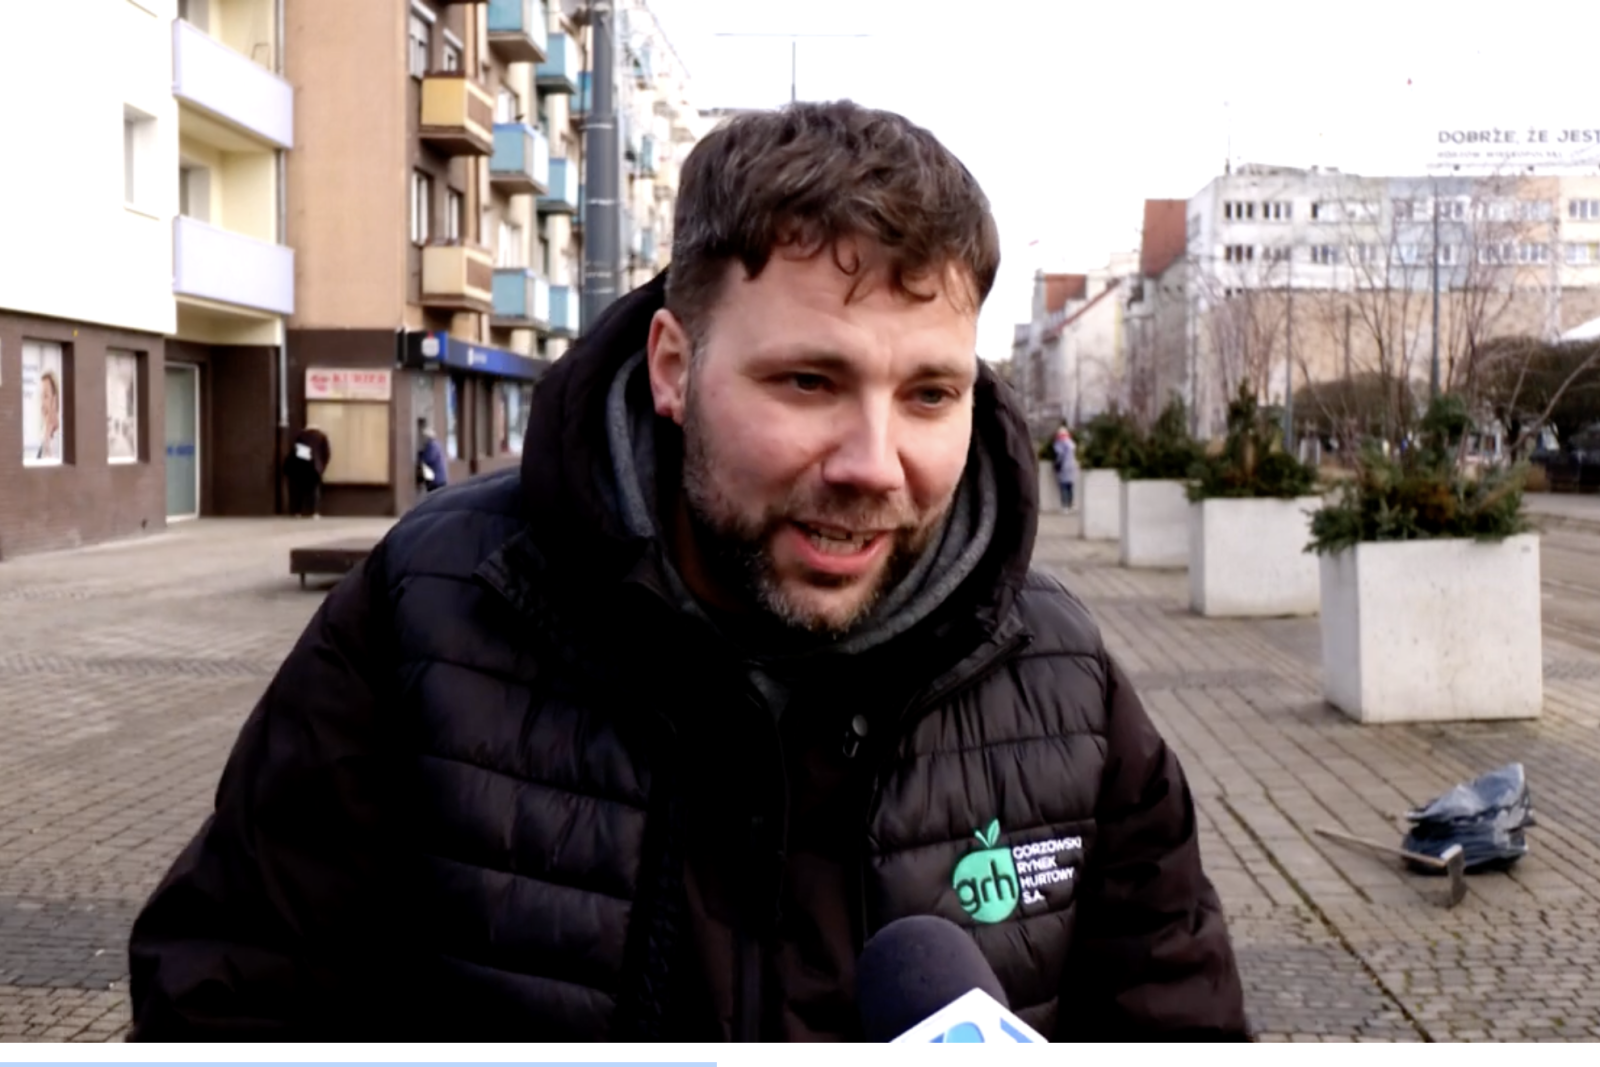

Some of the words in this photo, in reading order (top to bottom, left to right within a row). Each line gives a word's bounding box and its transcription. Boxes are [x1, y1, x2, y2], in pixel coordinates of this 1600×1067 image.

[1527, 126, 1549, 143] ŻE
[1012, 836, 1082, 859] GORZOWSKI
[1016, 856, 1057, 874] RYNEK
[956, 859, 1016, 915] grh
[1020, 867, 1075, 888] HURTOWY
